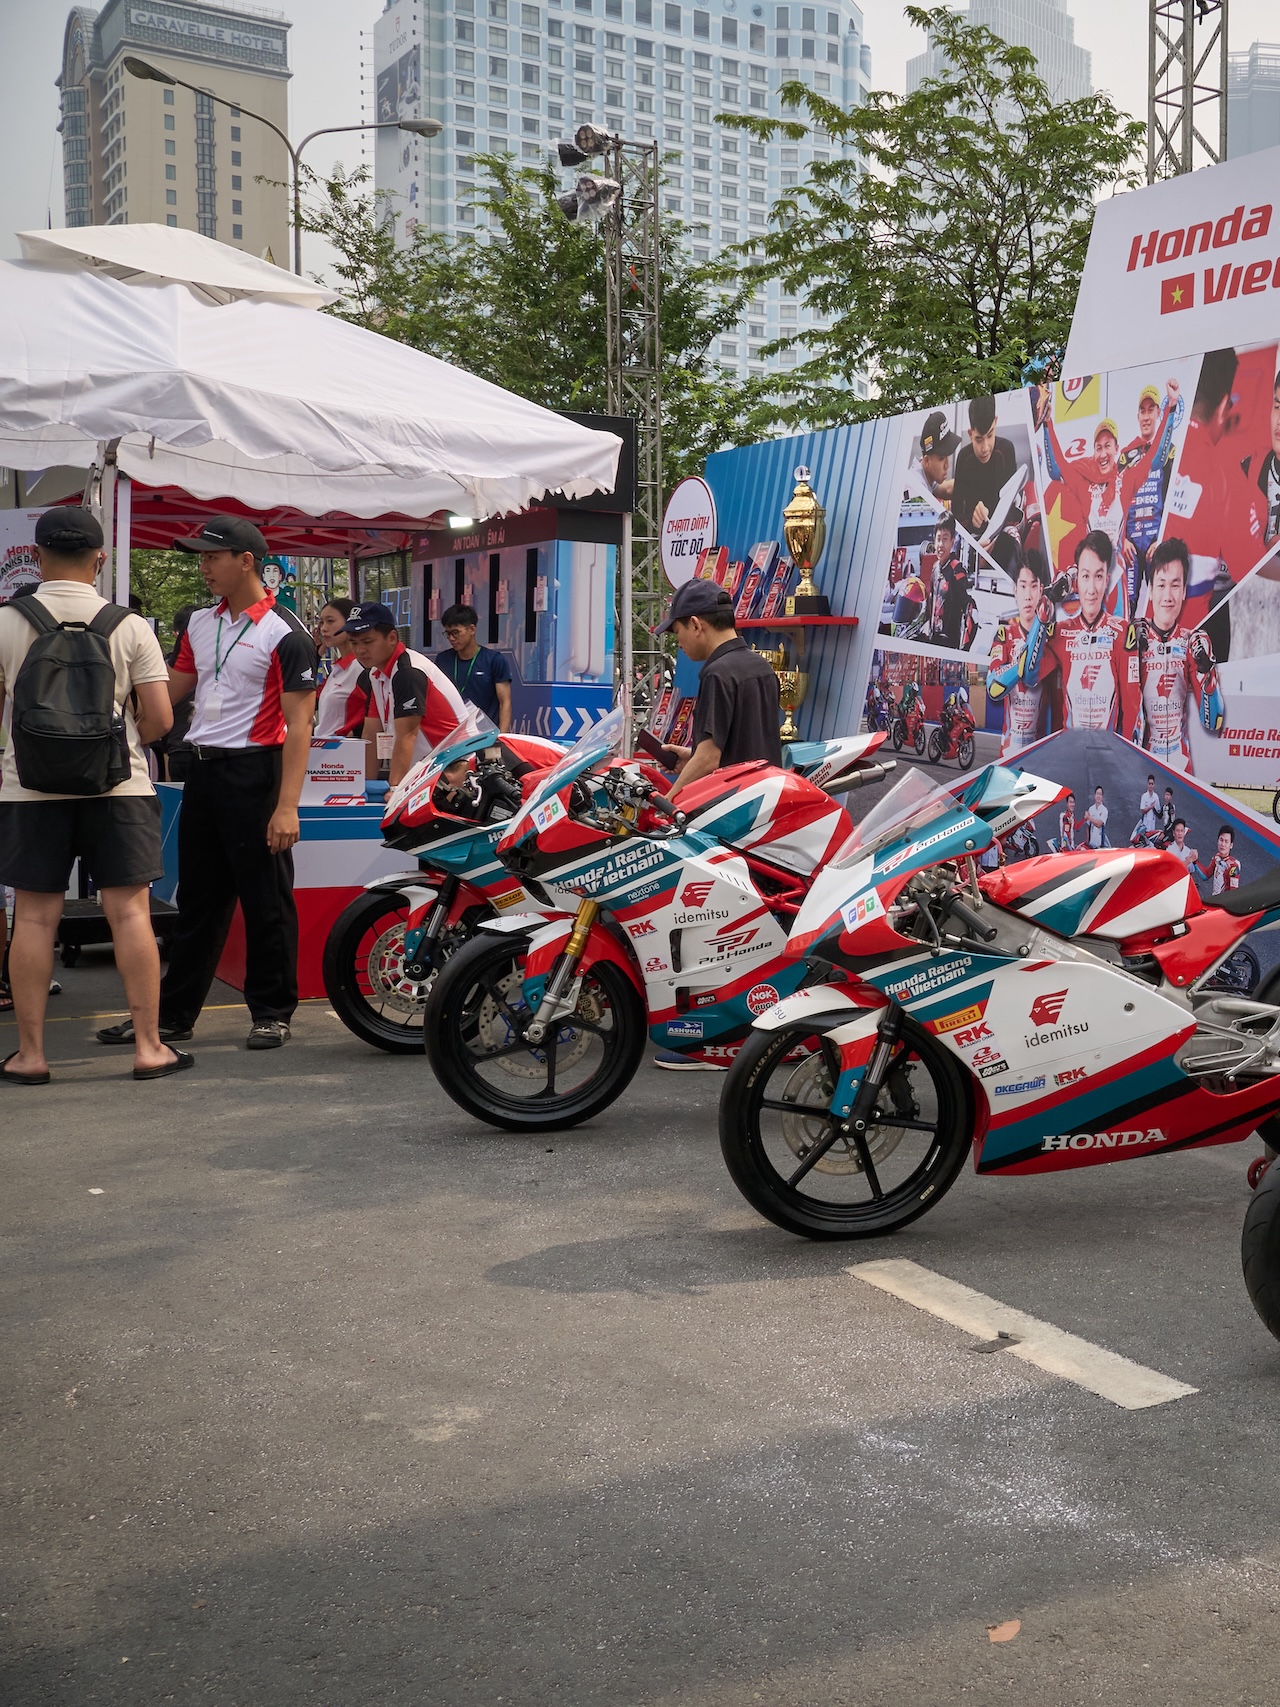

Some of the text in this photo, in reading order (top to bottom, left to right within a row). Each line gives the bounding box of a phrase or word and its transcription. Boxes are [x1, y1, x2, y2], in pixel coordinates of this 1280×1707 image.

[134, 12, 280, 53] CARAVELLE HOTEL
[389, 33, 407, 53] TUDOR
[1127, 204, 1272, 272] Honda
[453, 530, 506, 550] AN TOÀN ÊM ÁI
[236, 641, 254, 649] HONDA
[1072, 651, 1111, 661] HONDA
[1150, 699, 1181, 712] idemitsu
[1220, 727, 1264, 739] Honda
[538, 803, 558, 825] FPT
[615, 840, 670, 868] Racing
[494, 891, 524, 908] DUNLOP
[628, 882, 660, 901] nextone
[674, 909, 729, 924] idemitsu
[849, 896, 875, 923] FPT
[628, 920, 655, 937] RK
[884, 956, 972, 996] Honda Racing
[911, 966, 966, 998] Vietnam
[751, 990, 773, 1002] NGK
[939, 1008, 978, 1029] PIRELLI
[668, 1027, 701, 1036] ASHUKA
[953, 1022, 992, 1046] RK
[1025, 1022, 1089, 1048] idemitsu
[959, 1039, 981, 1049] TAKASAGO
[971, 1051, 1001, 1068] RCB
[1058, 1066, 1087, 1081] RK
[1041, 1128, 1168, 1152] HONDA
